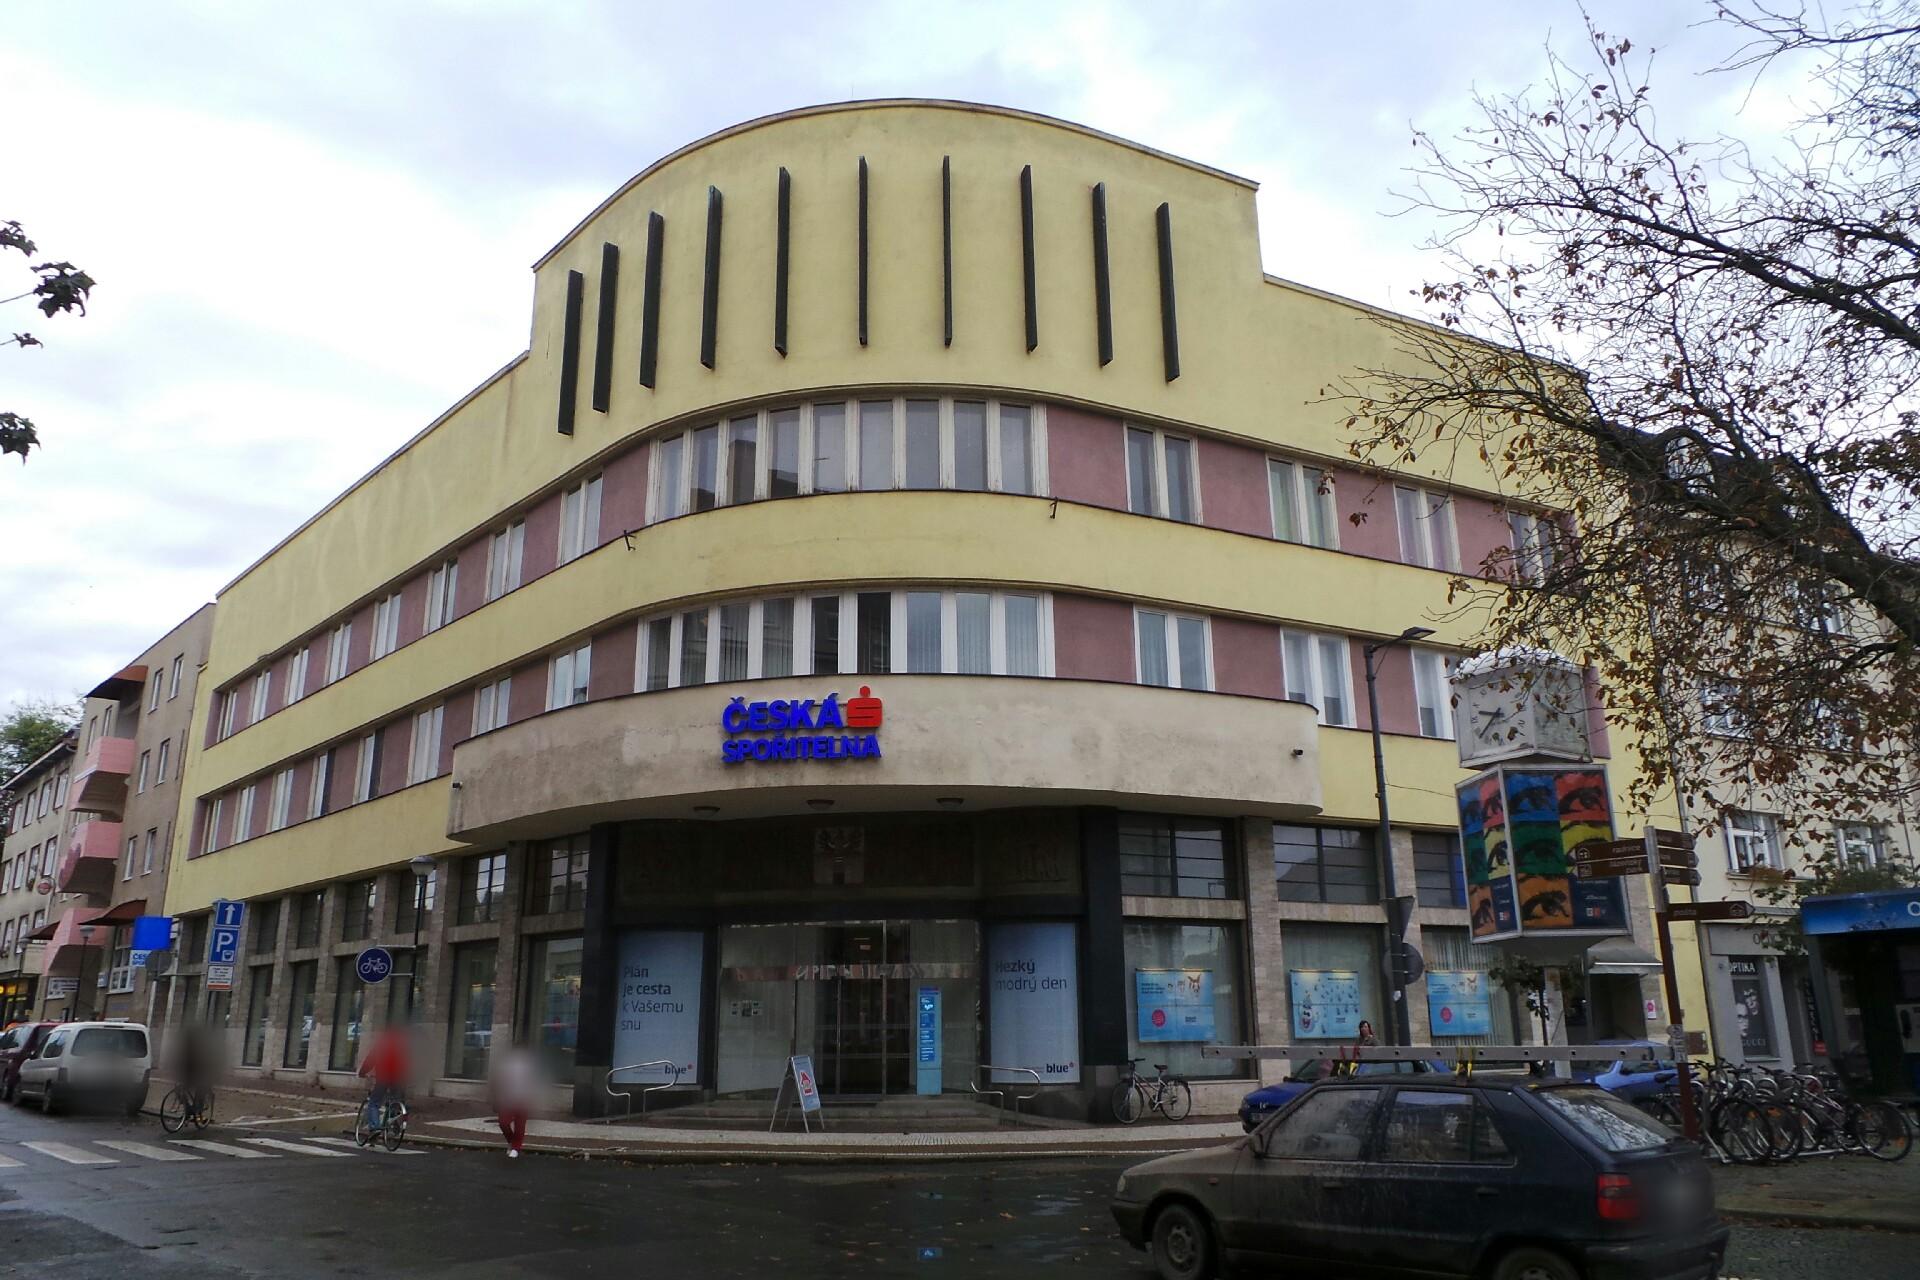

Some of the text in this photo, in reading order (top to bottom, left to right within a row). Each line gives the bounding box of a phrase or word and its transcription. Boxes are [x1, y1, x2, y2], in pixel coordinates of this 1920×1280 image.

[722, 692, 844, 734] ČESKÁ
[721, 732, 881, 763] SPOŘITELNA
[216, 932, 234, 953] P
[636, 984, 672, 995] cesta
[1041, 977, 1067, 990] den
[631, 999, 684, 1013] Vašemu
[620, 1019, 641, 1031] snu
[1046, 1063, 1069, 1074] blue
